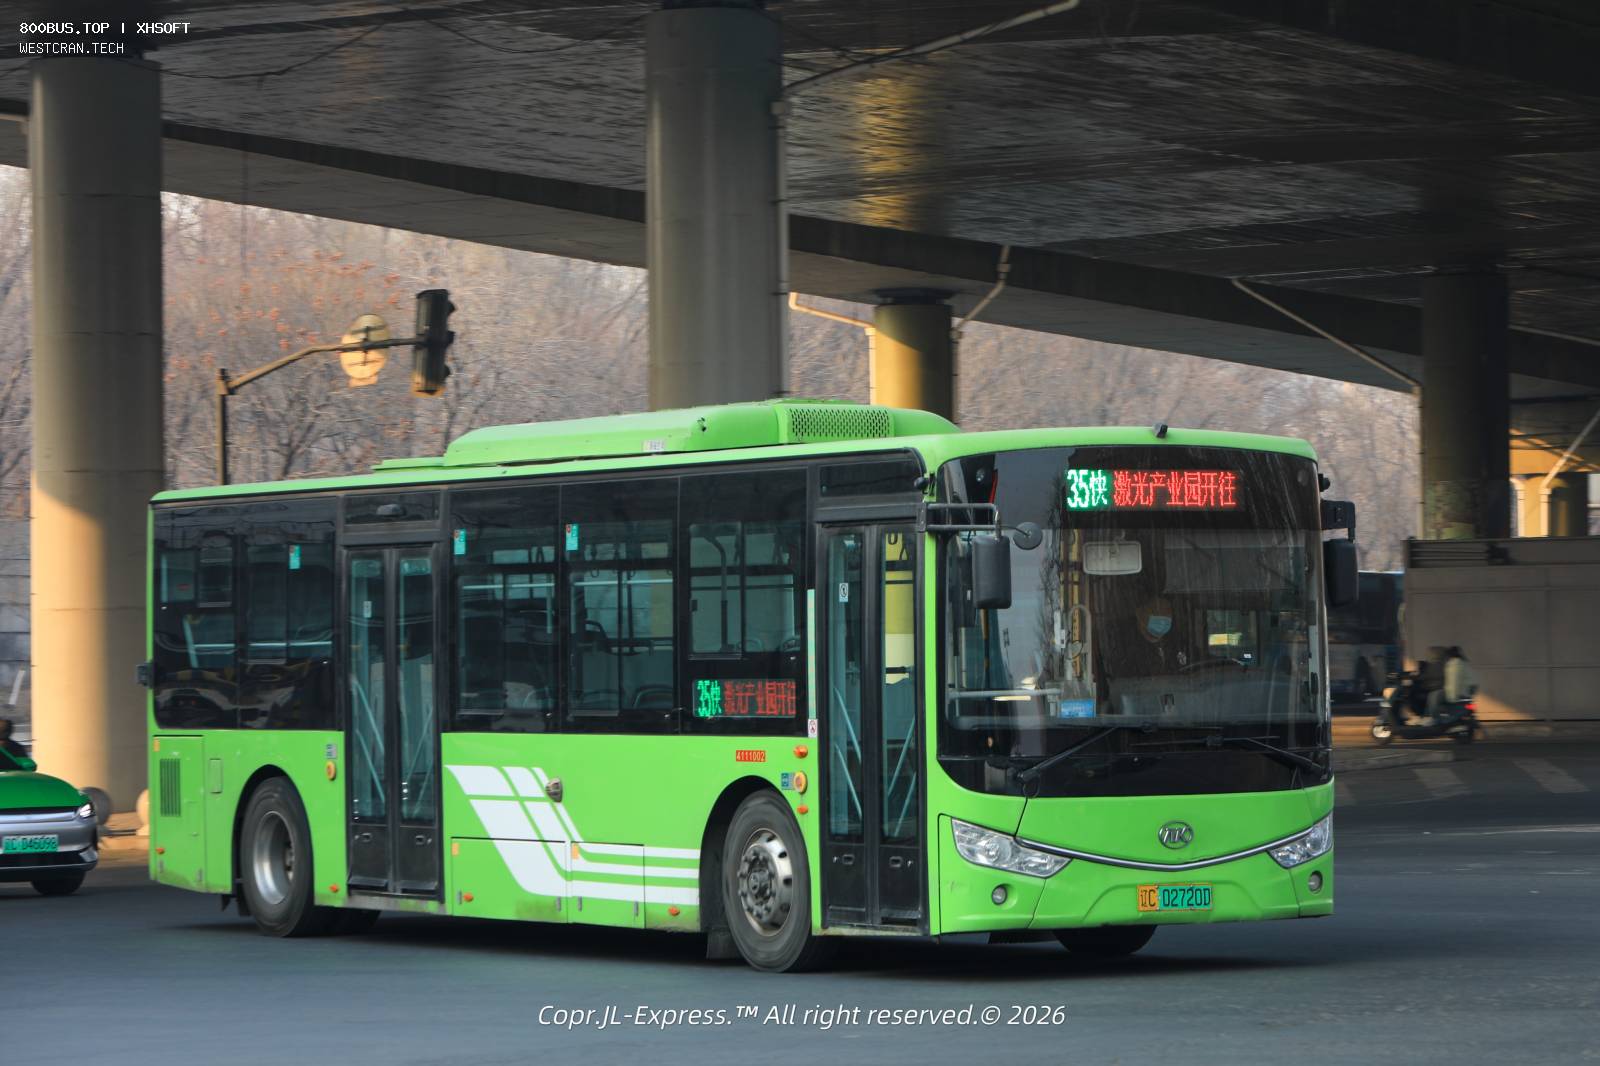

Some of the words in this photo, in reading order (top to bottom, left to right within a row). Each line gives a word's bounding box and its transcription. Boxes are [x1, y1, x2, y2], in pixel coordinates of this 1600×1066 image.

[1066, 469, 1108, 508] 35快
[1113, 471, 1237, 507] 激光产业园开往
[736, 751, 765, 762] 4111002
